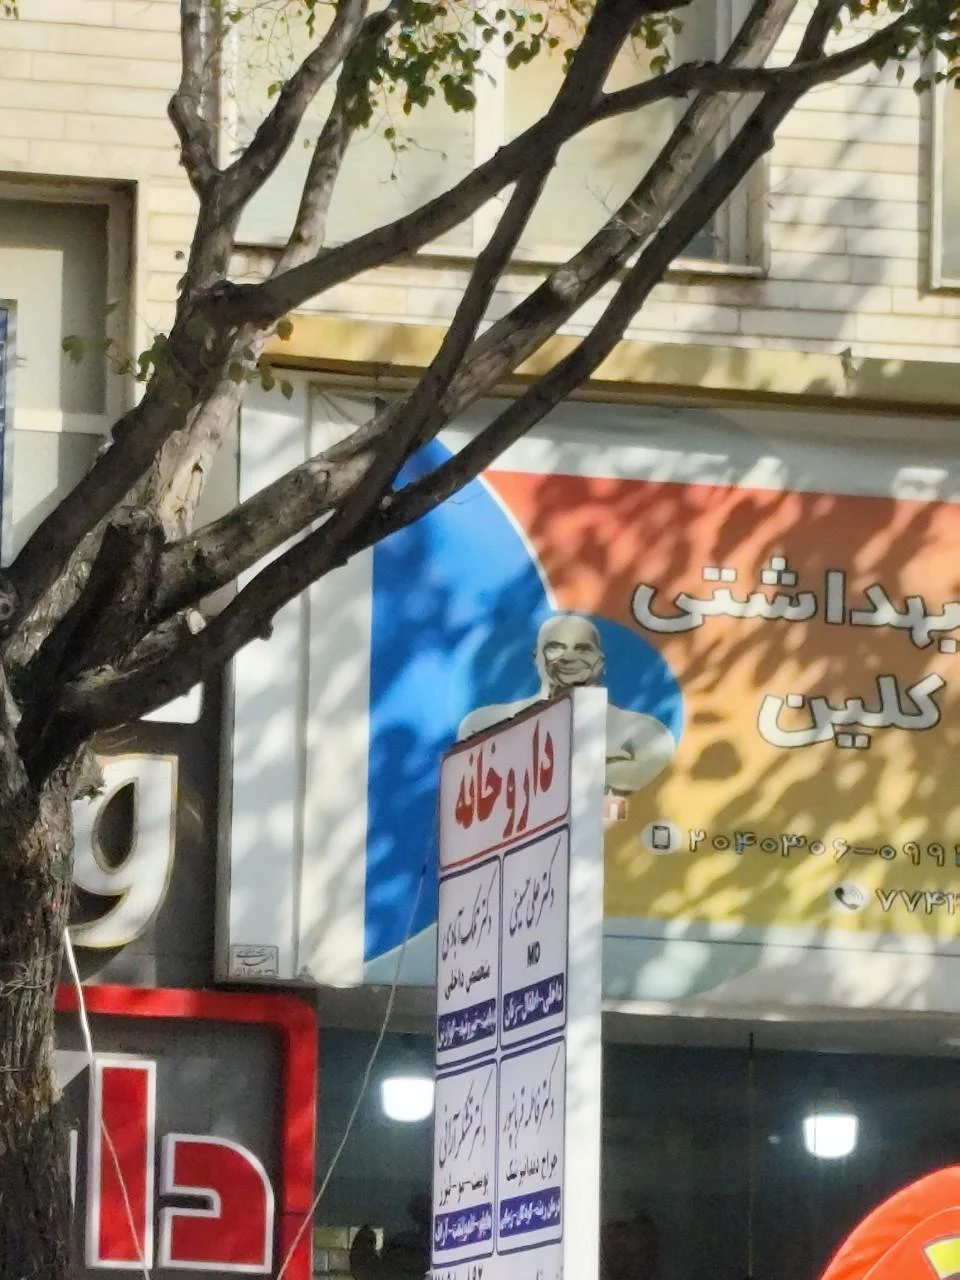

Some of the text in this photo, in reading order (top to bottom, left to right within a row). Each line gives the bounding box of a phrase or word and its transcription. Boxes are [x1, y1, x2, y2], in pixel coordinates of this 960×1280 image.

[756, 671, 947, 750] کلین
[453, 718, 556, 839] داروخانه
[536, 834, 562, 932] دکتر
[526, 940, 541, 969] MD
